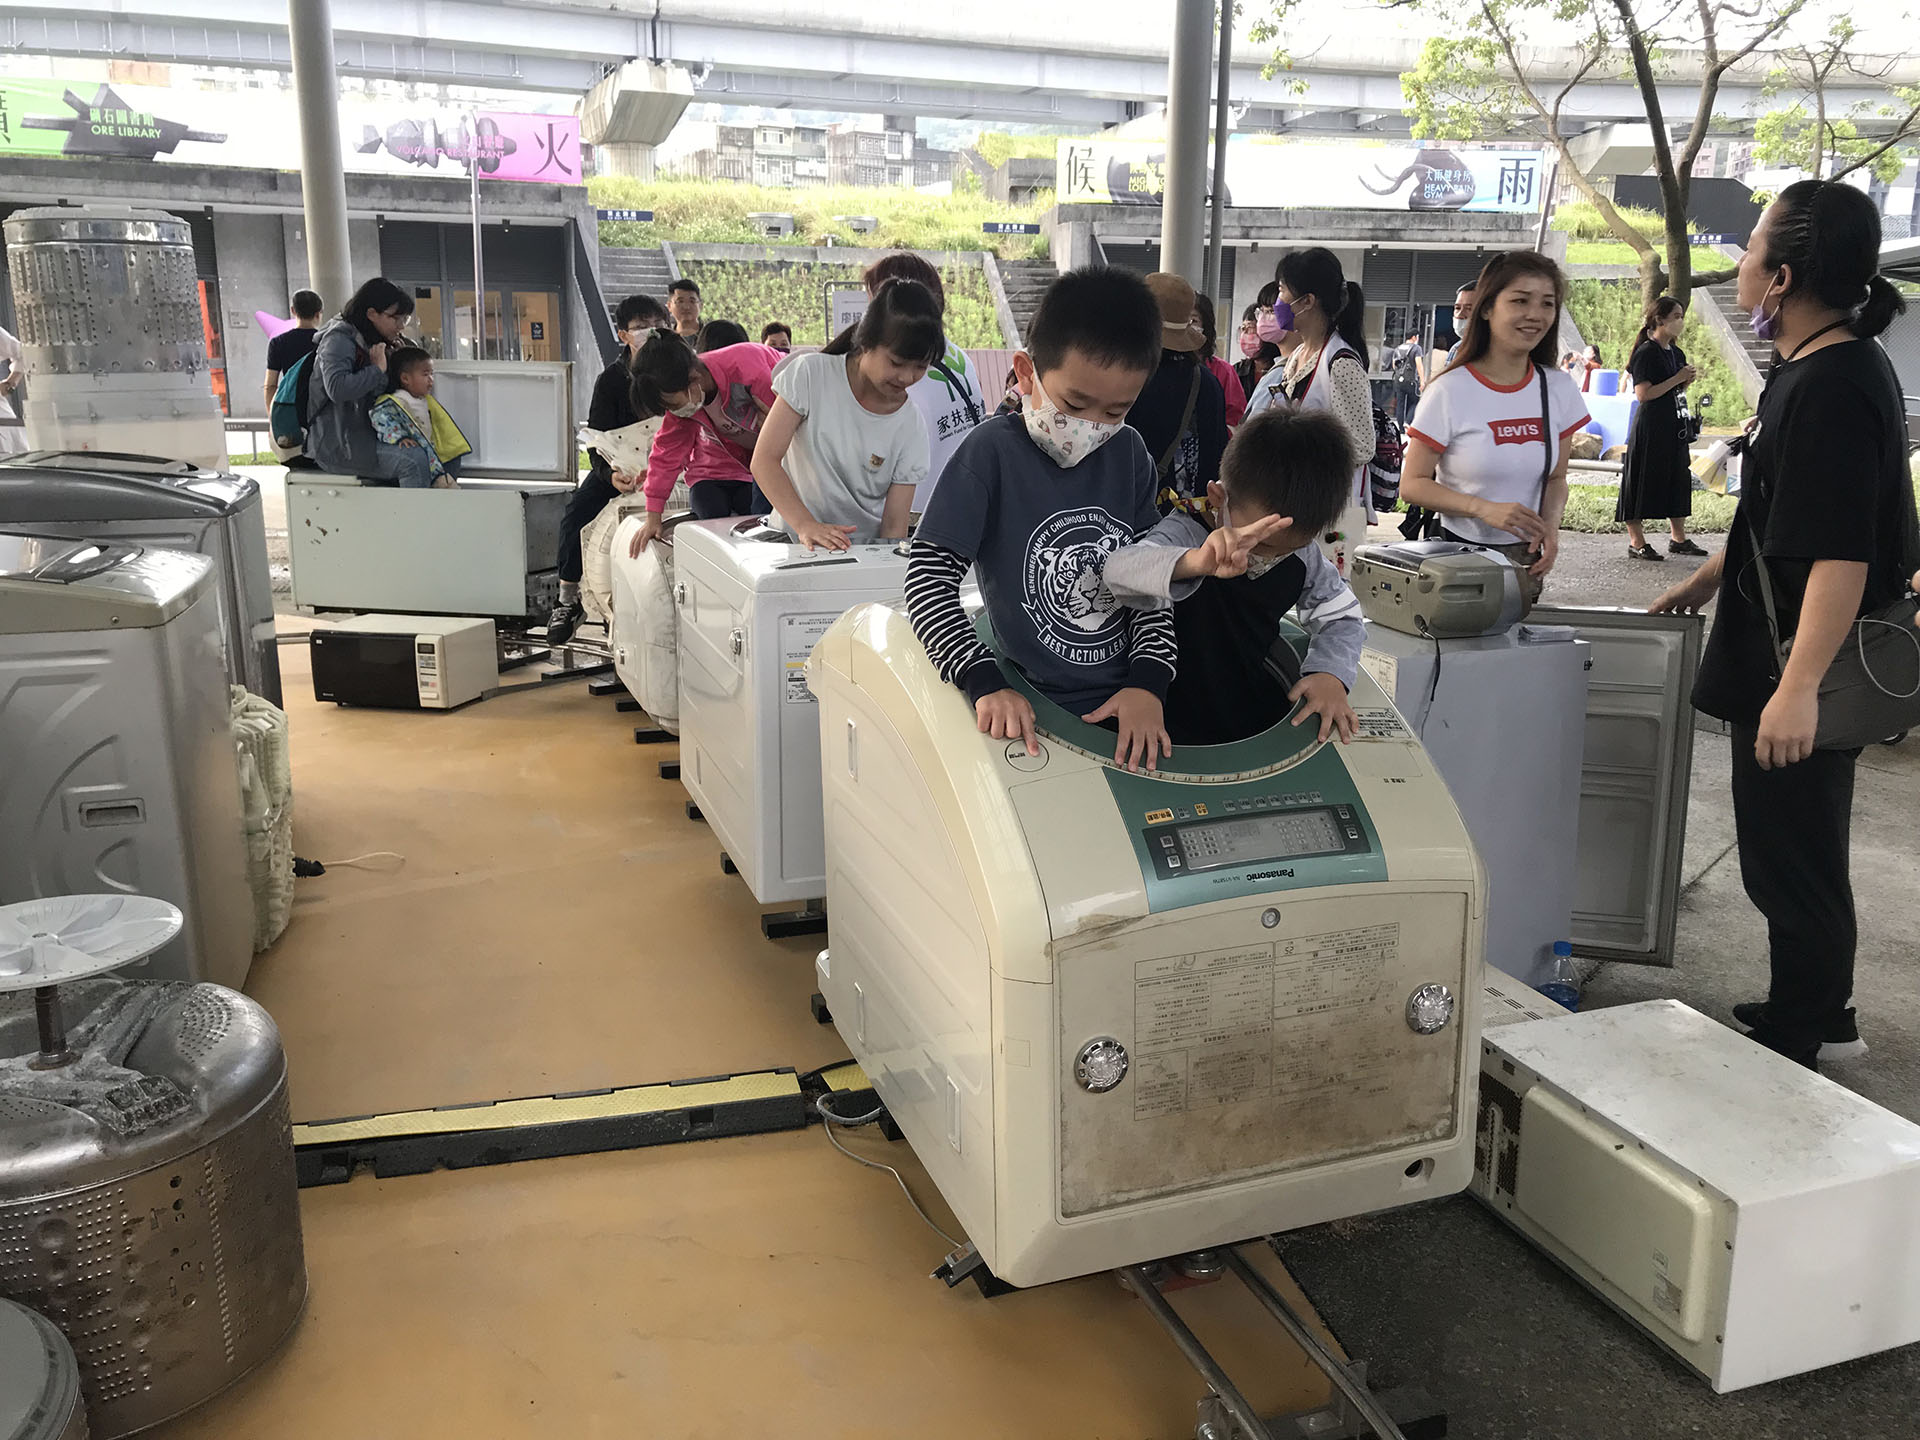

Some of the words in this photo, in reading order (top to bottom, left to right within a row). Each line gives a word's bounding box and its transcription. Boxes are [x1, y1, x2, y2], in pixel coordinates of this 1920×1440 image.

[91, 124, 115, 136] ORE
[118, 126, 161, 139] LIBRARY
[396, 145, 445, 157] VOLCANO
[446, 148, 505, 159] RESTAURANT
[533, 123, 573, 176] 火
[1065, 145, 1096, 195] 候
[1424, 184, 1451, 192] HEAVY
[1453, 184, 1474, 192] RAIN
[1497, 158, 1537, 205] 雨
[1423, 191, 1443, 199] GYM
[1032, 528, 1052, 554] HAPPY
[1050, 514, 1087, 533] CHILDHOOD
[1043, 633, 1068, 656] BEST
[1069, 648, 1106, 662] ACTION
[1246, 867, 1295, 882] Panasonic
